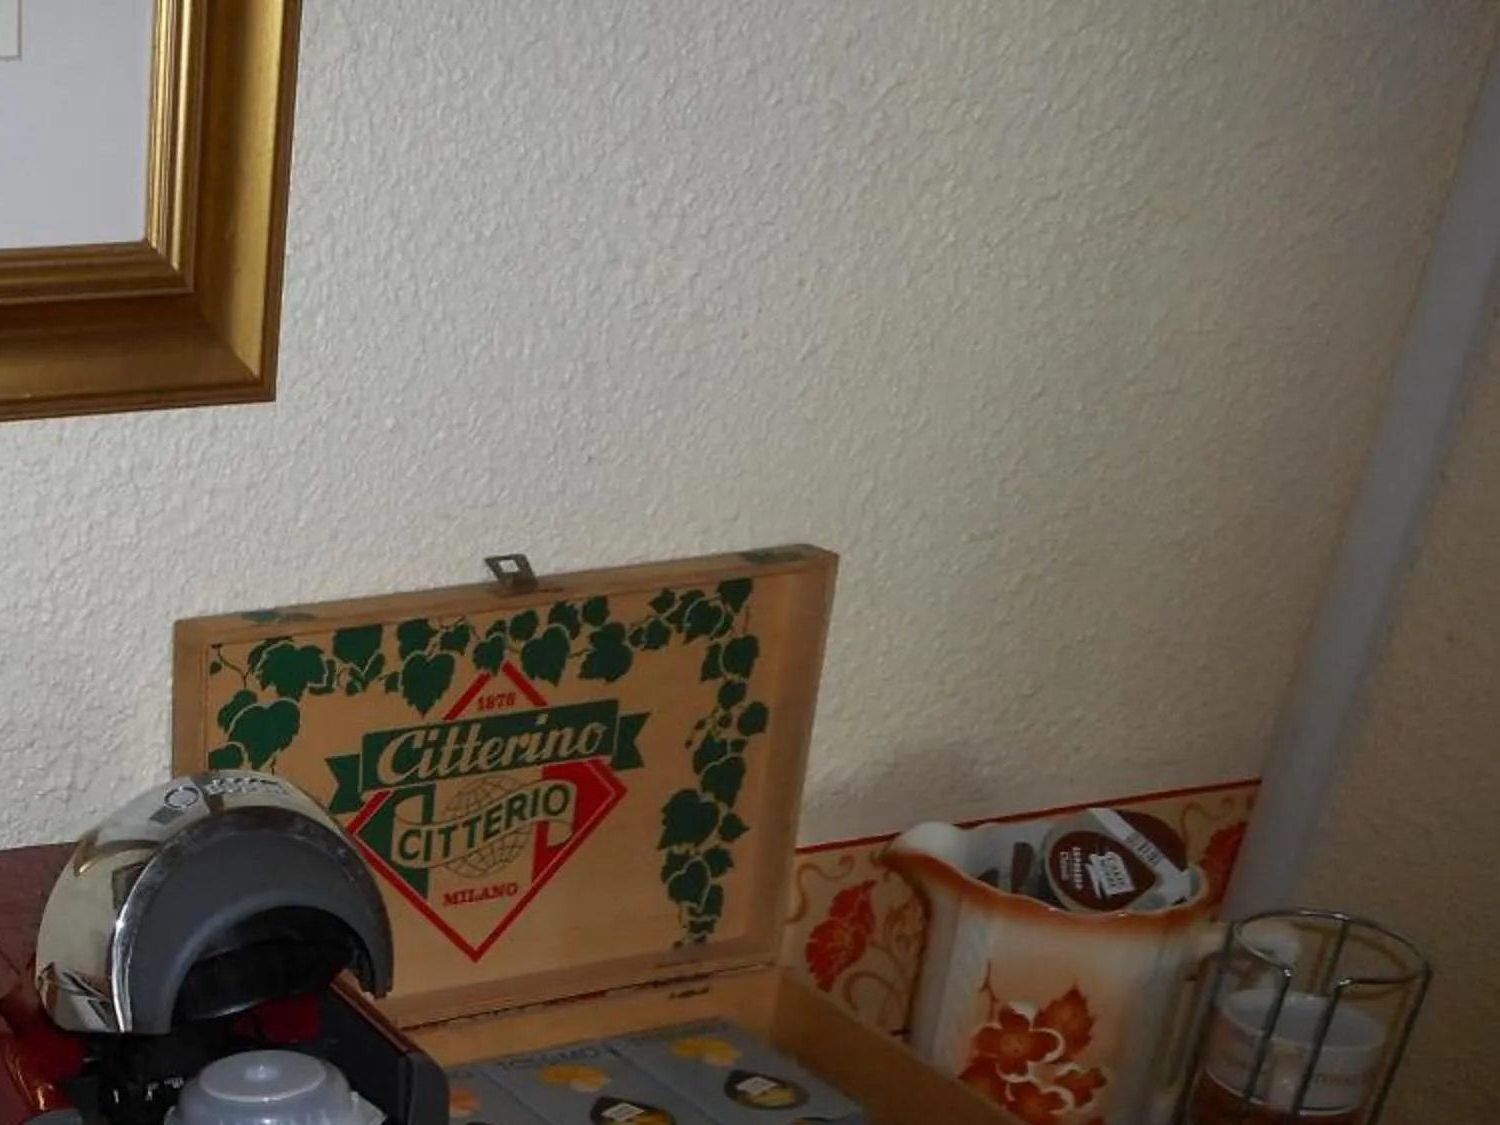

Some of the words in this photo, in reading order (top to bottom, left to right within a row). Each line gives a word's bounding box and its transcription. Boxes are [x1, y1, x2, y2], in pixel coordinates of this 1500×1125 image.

[377, 714, 608, 786] Citterino
[399, 784, 570, 861] CITTERIO
[443, 883, 519, 906] MILANO
